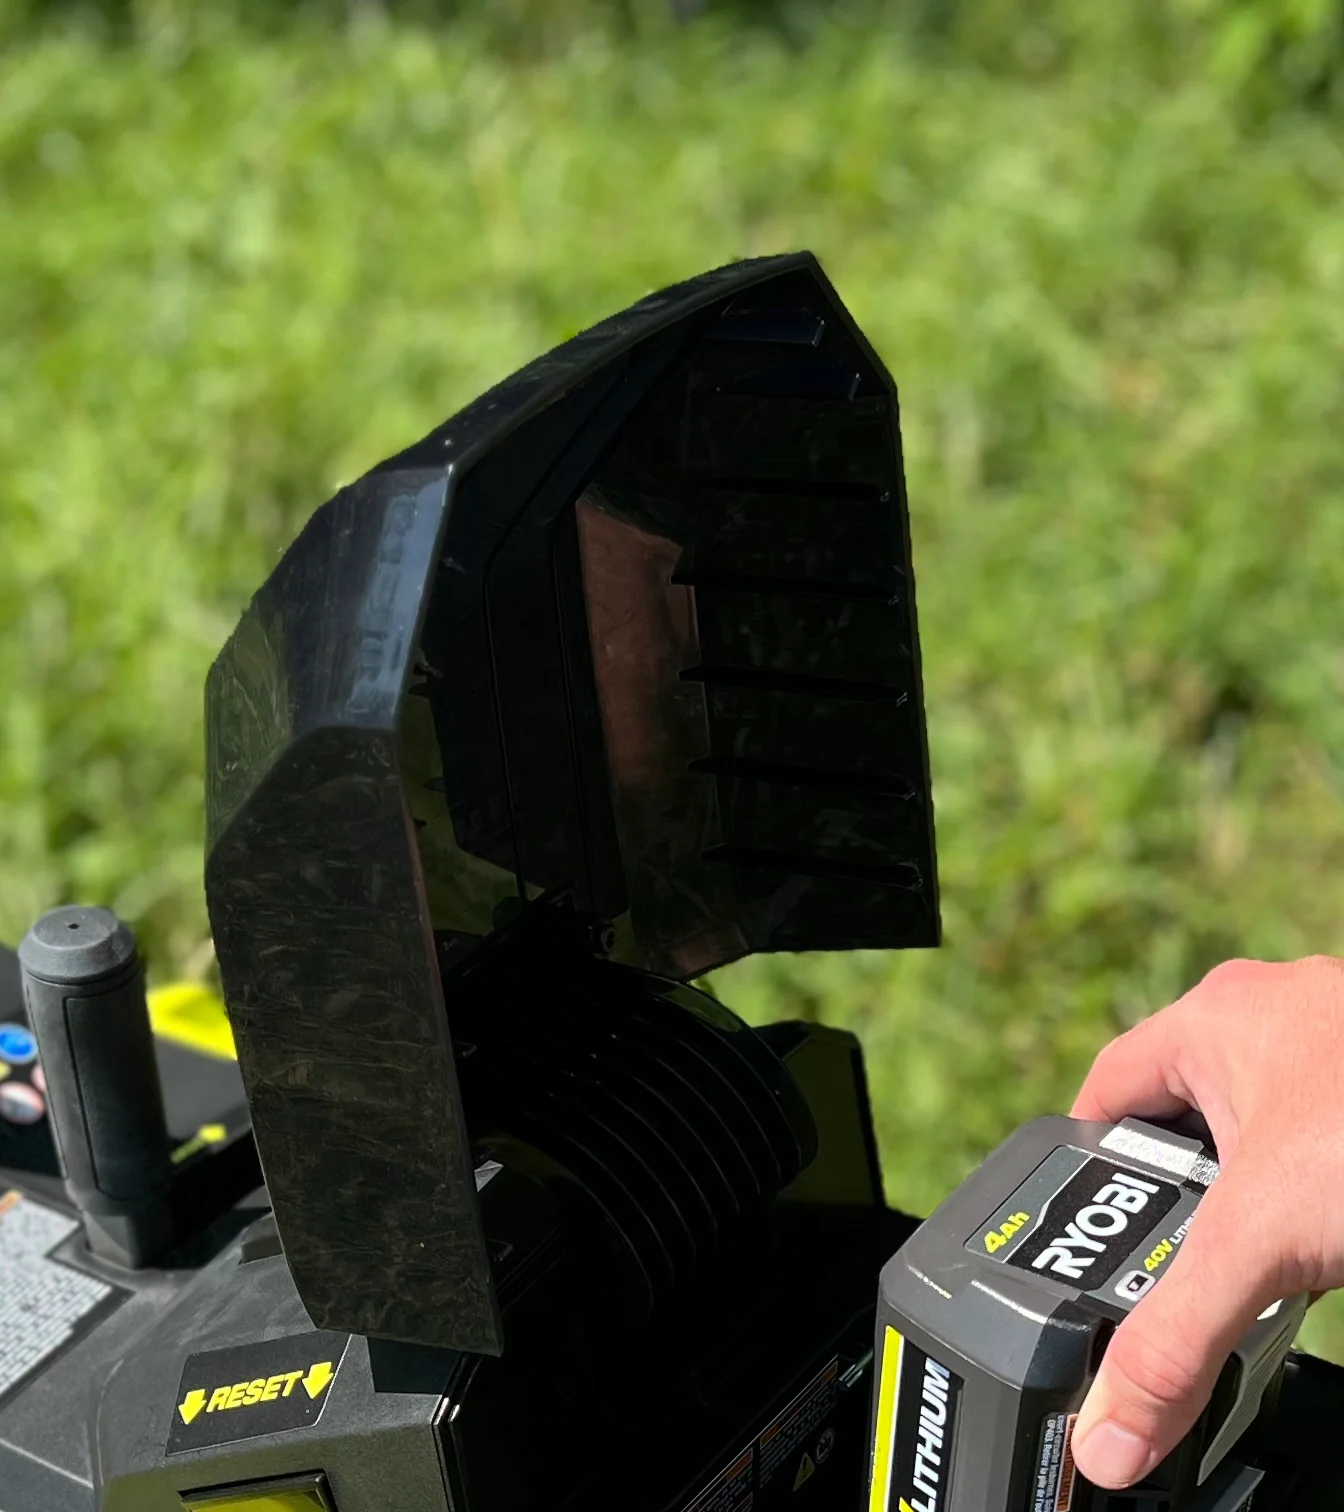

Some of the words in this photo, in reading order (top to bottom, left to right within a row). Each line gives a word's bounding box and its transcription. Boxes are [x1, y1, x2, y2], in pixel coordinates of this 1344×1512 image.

[983, 1211, 1031, 1254] 4Ah
[1031, 1172, 1160, 1279] RYOBI
[1143, 1238, 1174, 1272] 40V
[206, 1370, 304, 1412] RESET
